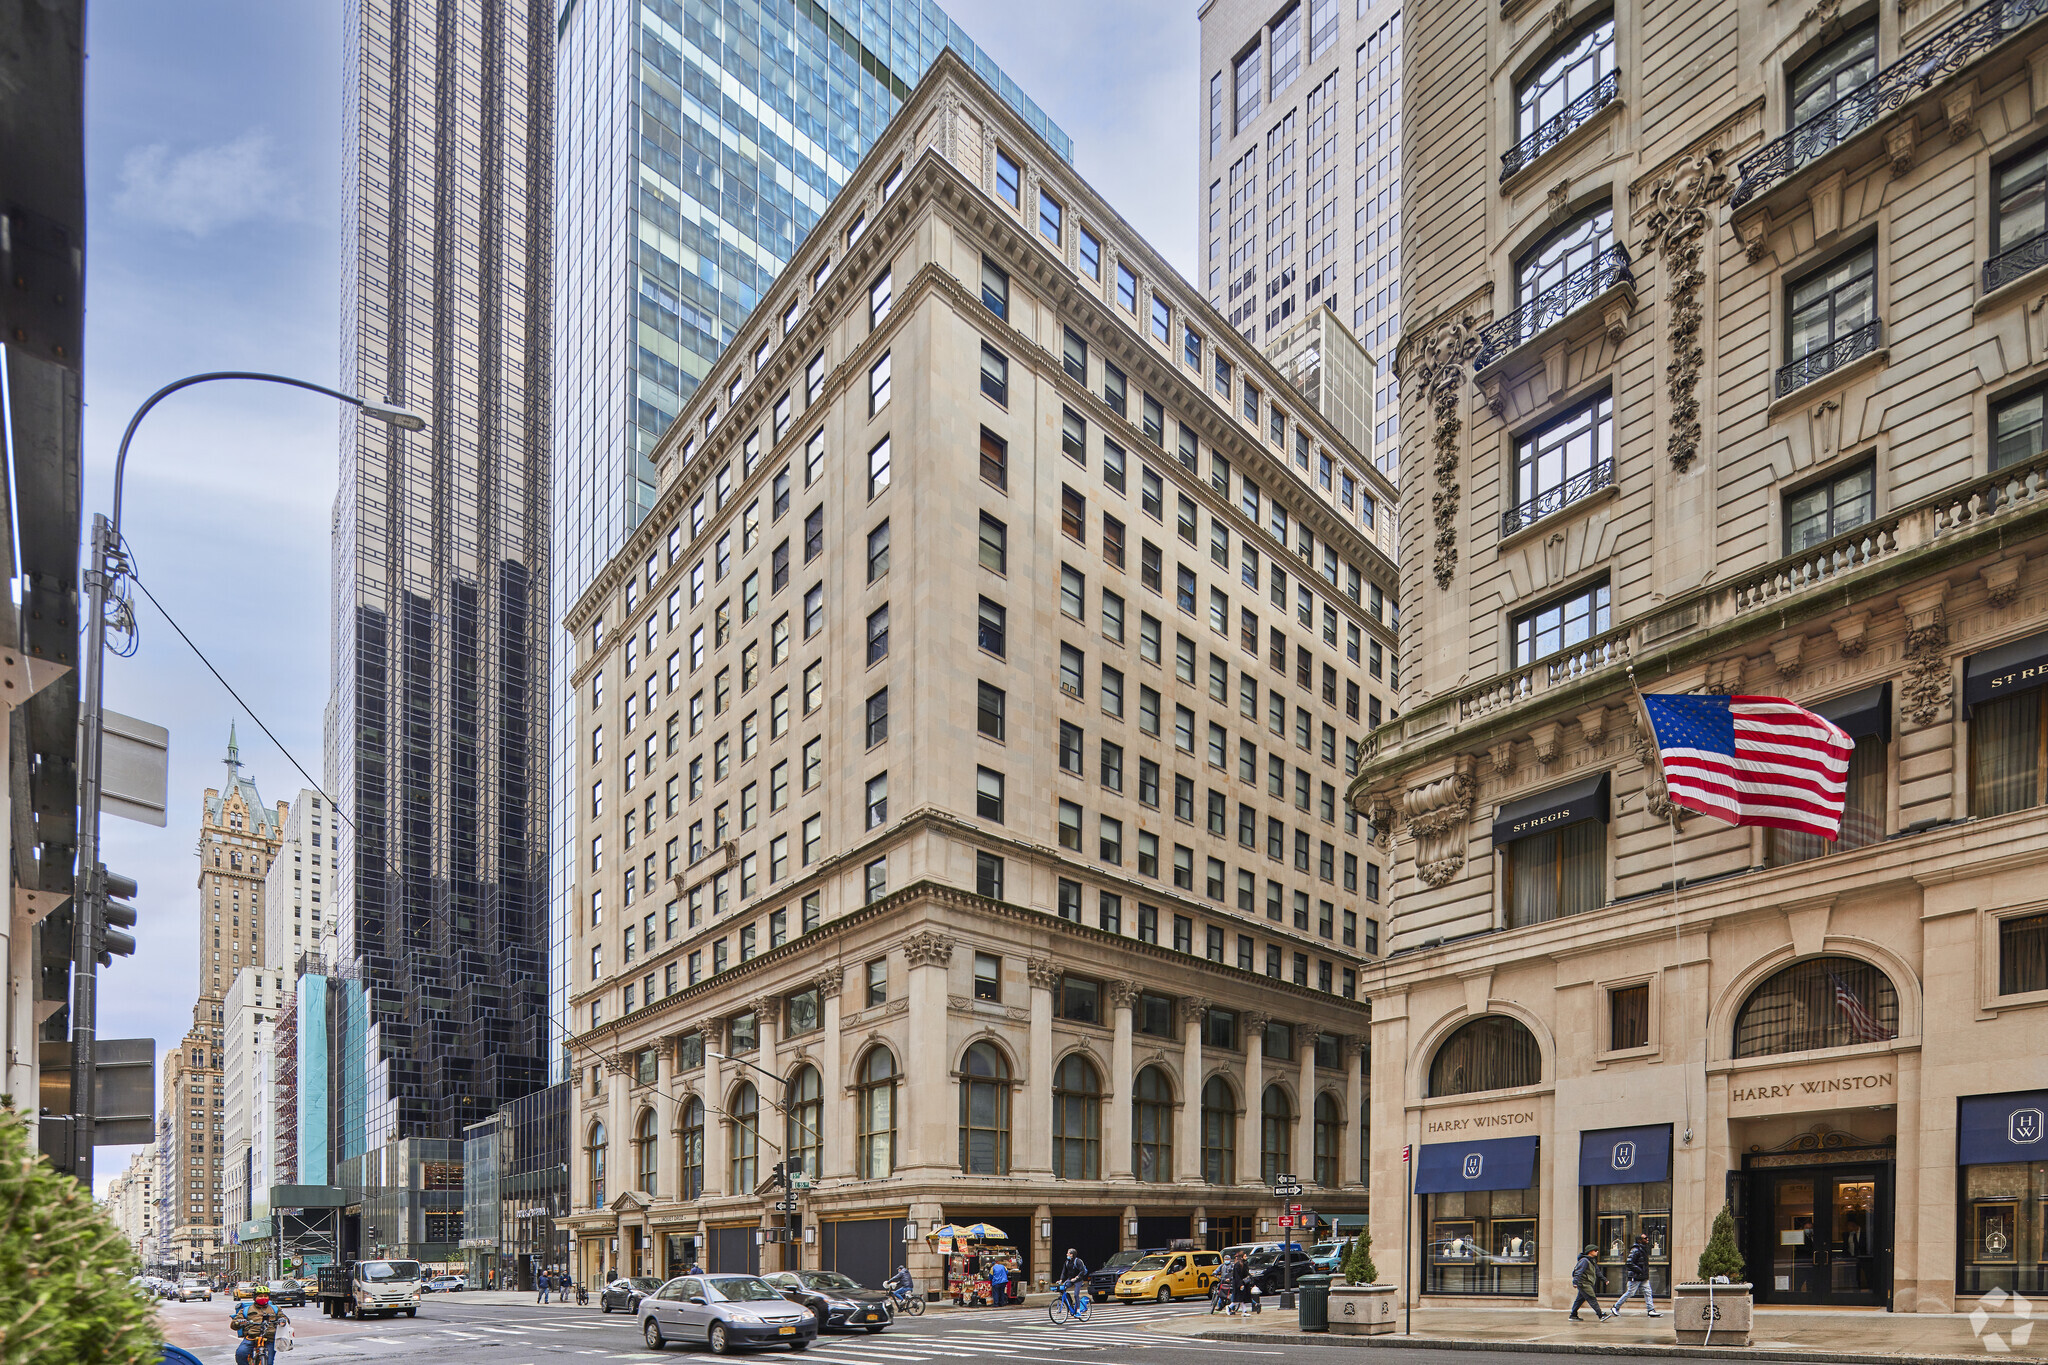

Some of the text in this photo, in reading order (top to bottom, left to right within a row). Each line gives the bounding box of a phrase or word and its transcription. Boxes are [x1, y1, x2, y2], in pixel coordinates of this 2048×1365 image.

[1992, 673, 2016, 688] ST
[1513, 809, 1570, 832] ST REGIS
[1733, 1073, 1892, 1102] HARRY WINSTON
[1428, 1111, 1534, 1133] HARRY WINSTON
[2020, 1115, 2032, 1127] H
[2016, 1126, 2036, 1138] W
[1620, 1147, 1628, 1156] H
[1469, 1158, 1477, 1167] H
[1617, 1156, 1630, 1165] W
[1467, 1166, 1478, 1175] W
